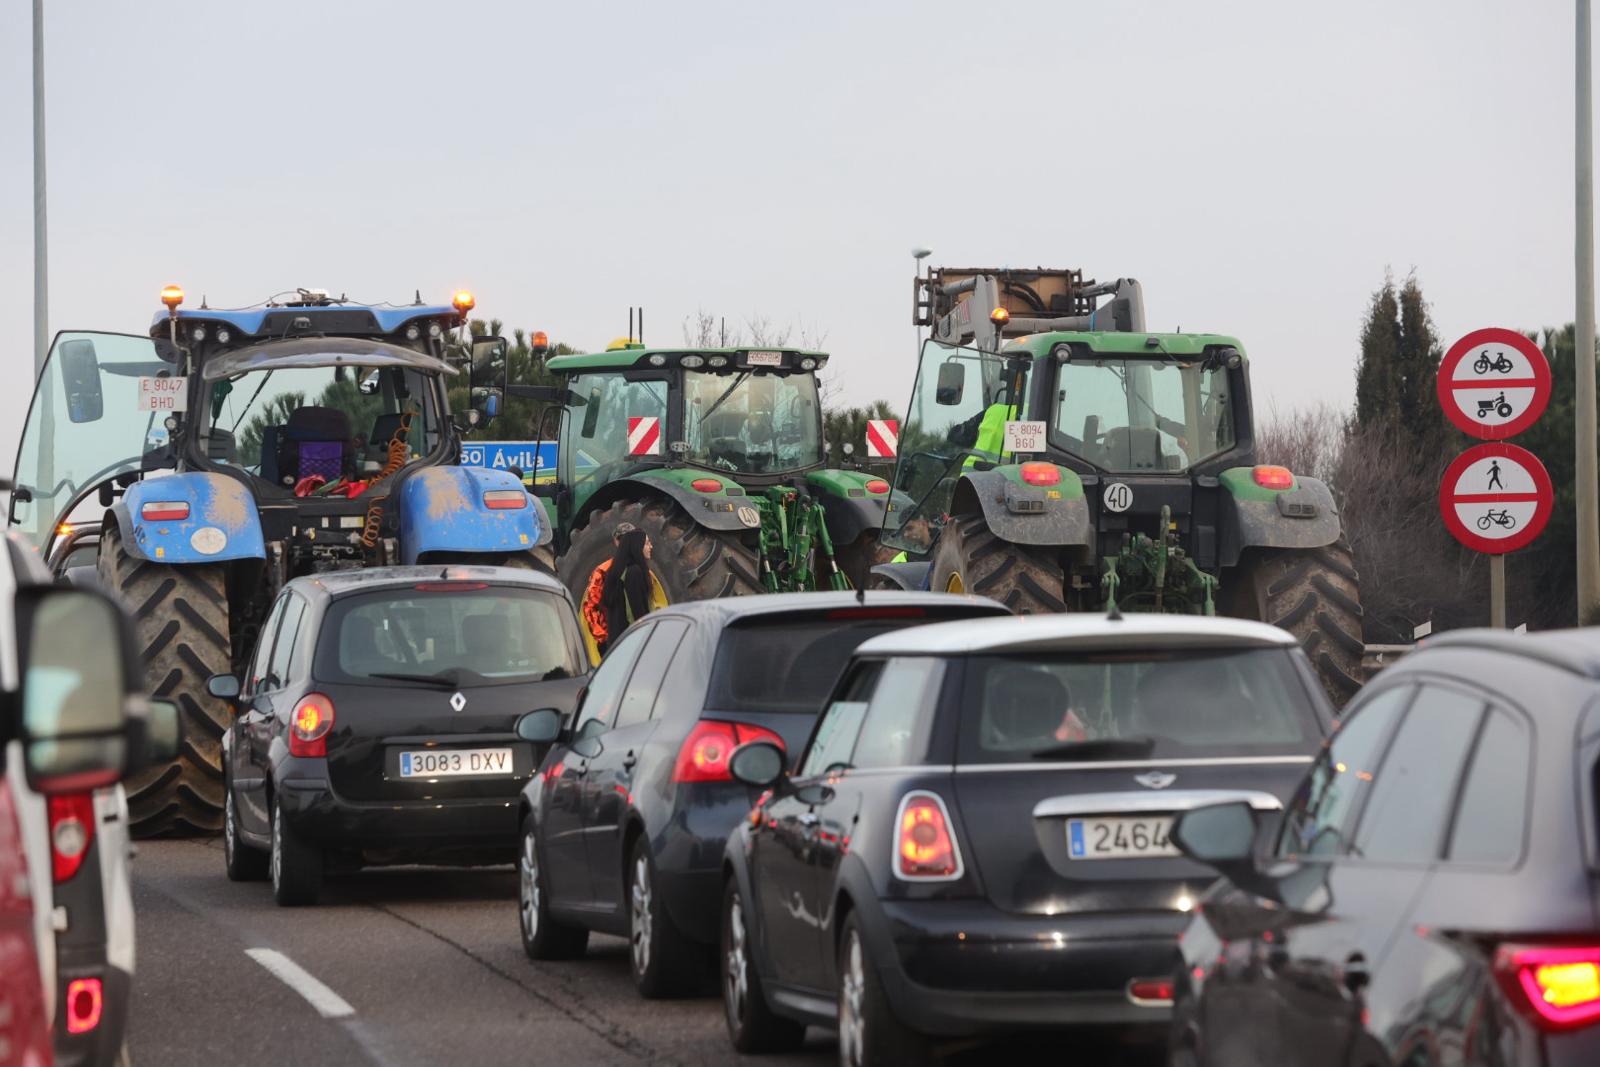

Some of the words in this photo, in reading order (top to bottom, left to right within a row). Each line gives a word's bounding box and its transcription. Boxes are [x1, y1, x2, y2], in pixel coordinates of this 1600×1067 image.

[143, 379, 150, 391] E
[154, 379, 183, 391] 9047
[150, 396, 175, 409] BHD
[1008, 424, 1016, 435] E
[1020, 424, 1042, 435] 8094
[492, 448, 545, 468] Ávila
[1108, 486, 1127, 508] 40
[413, 754, 461, 773] 3083
[470, 752, 506, 771] DXV
[1094, 822, 1169, 852] 2464
